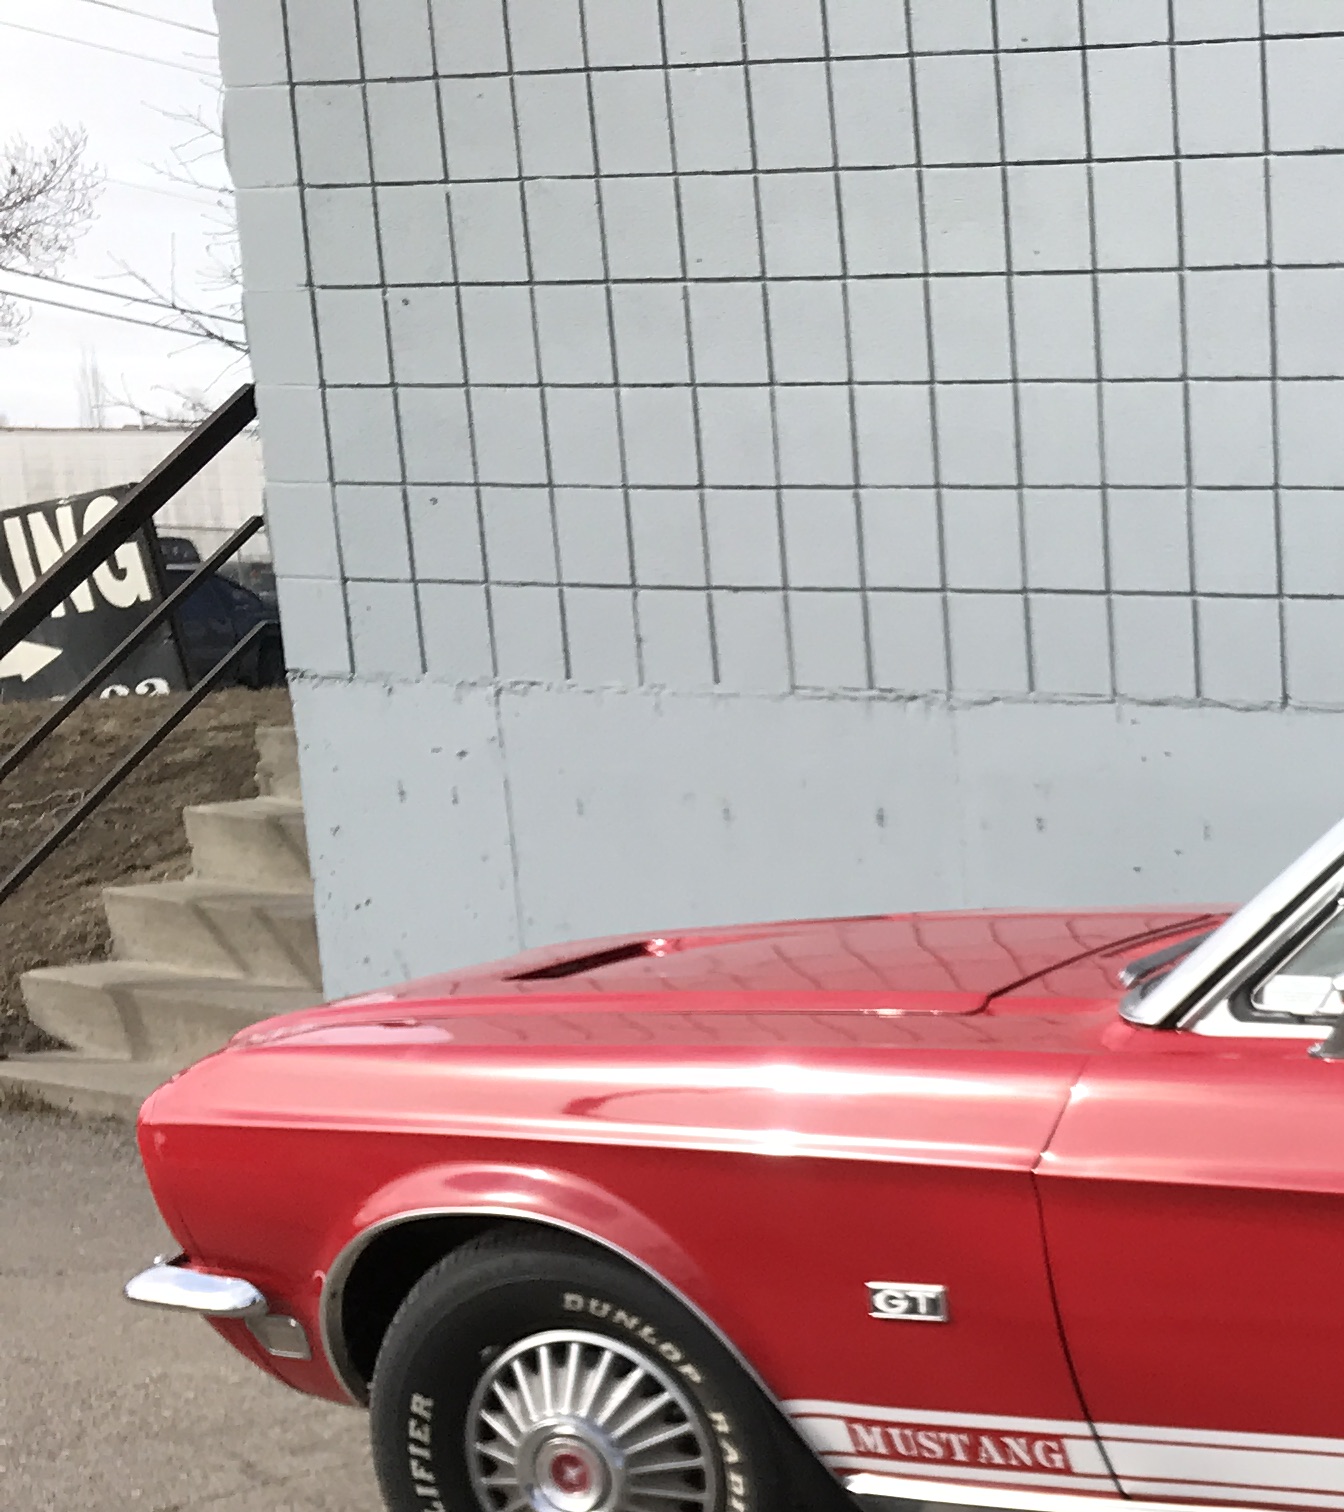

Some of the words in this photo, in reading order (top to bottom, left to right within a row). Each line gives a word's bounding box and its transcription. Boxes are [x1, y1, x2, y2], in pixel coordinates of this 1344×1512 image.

[0, 495, 152, 618] ING
[872, 1289, 936, 1315] GT
[564, 1293, 702, 1384] DUNLOP
[850, 1423, 1067, 1469] MUSTANG
